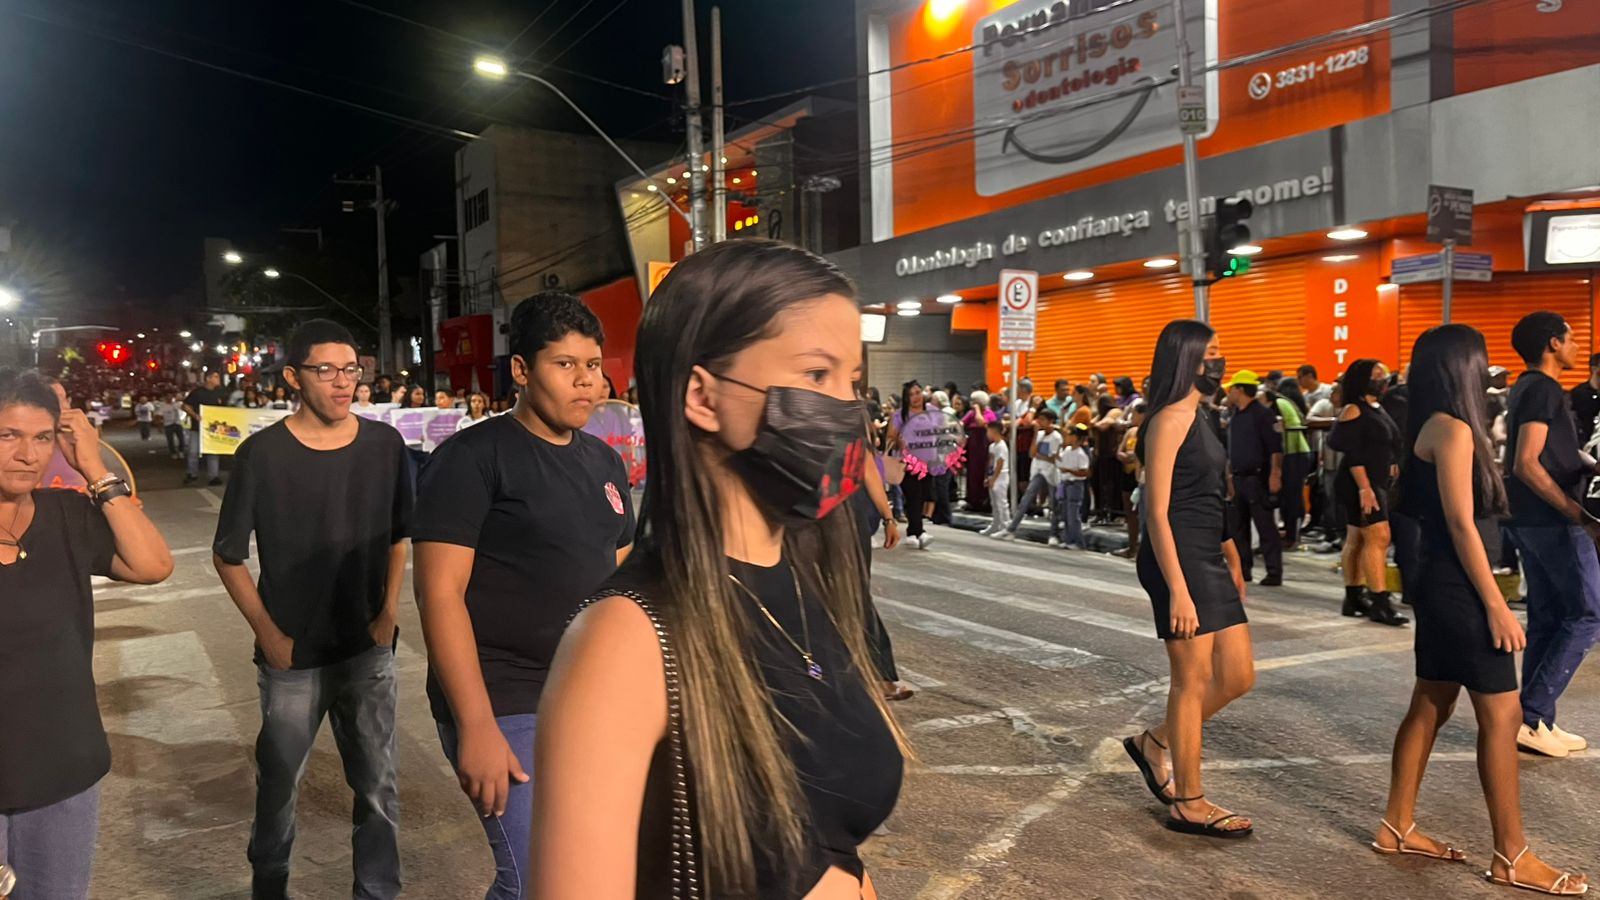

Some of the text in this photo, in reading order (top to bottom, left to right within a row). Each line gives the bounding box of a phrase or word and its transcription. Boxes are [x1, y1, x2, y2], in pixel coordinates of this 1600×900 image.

[1002, 10, 1161, 92] Sorrisos
[1012, 56, 1143, 113] odontologia
[1275, 45, 1369, 89] 3831-1228
[895, 241, 993, 277] Odontologia
[1002, 234, 1028, 256] de
[1038, 209, 1149, 248] confiança
[1333, 278, 1349, 376] DENT
